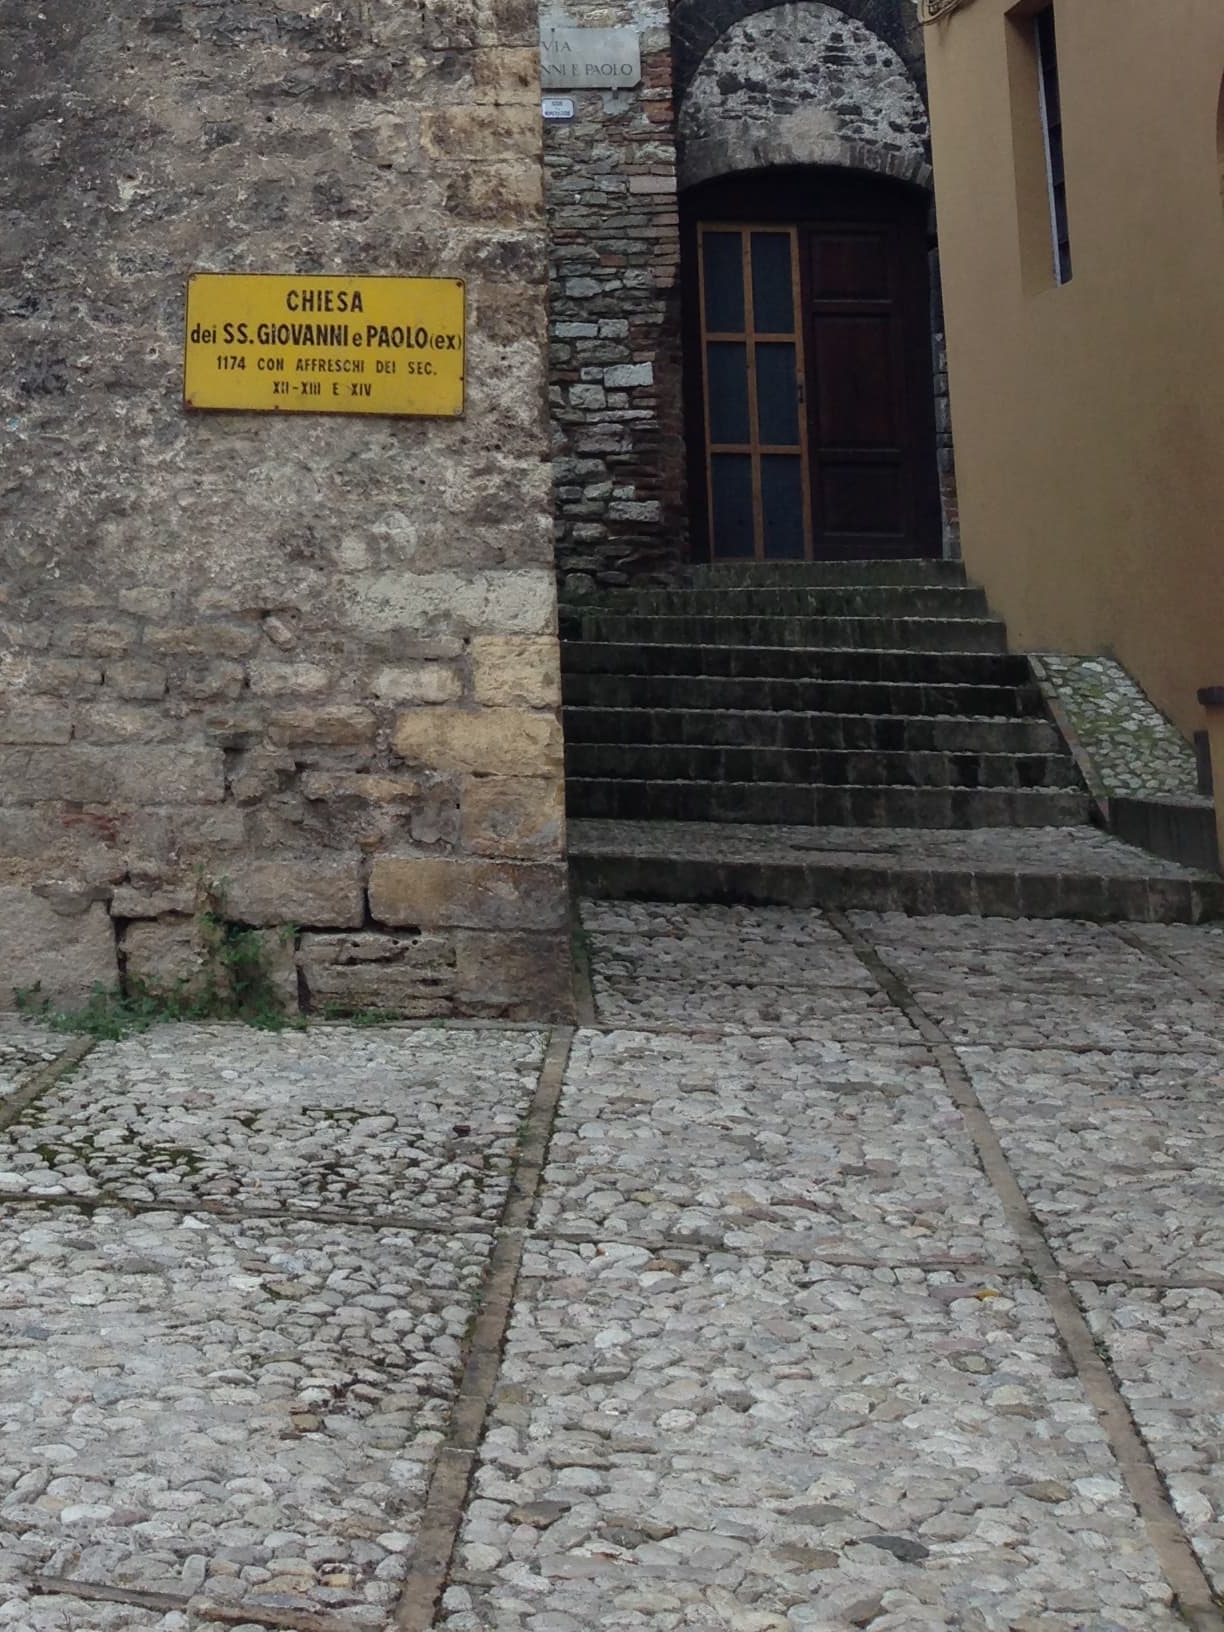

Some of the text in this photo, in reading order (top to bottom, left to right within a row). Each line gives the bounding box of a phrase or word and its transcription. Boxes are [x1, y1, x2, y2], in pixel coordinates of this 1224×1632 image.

[541, 41, 572, 52] VIA
[585, 63, 633, 76] PAOLO
[286, 290, 363, 312] CHIESA
[190, 323, 216, 344] dei
[223, 322, 254, 345] SS.
[257, 323, 348, 346] GIOVANNI
[352, 332, 363, 347] e
[366, 325, 428, 349] PAOLO
[217, 355, 437, 375] 1174 CON AFFRESCHI DEI SEC.
[333, 382, 339, 396] E
[351, 382, 372, 396] XIV
